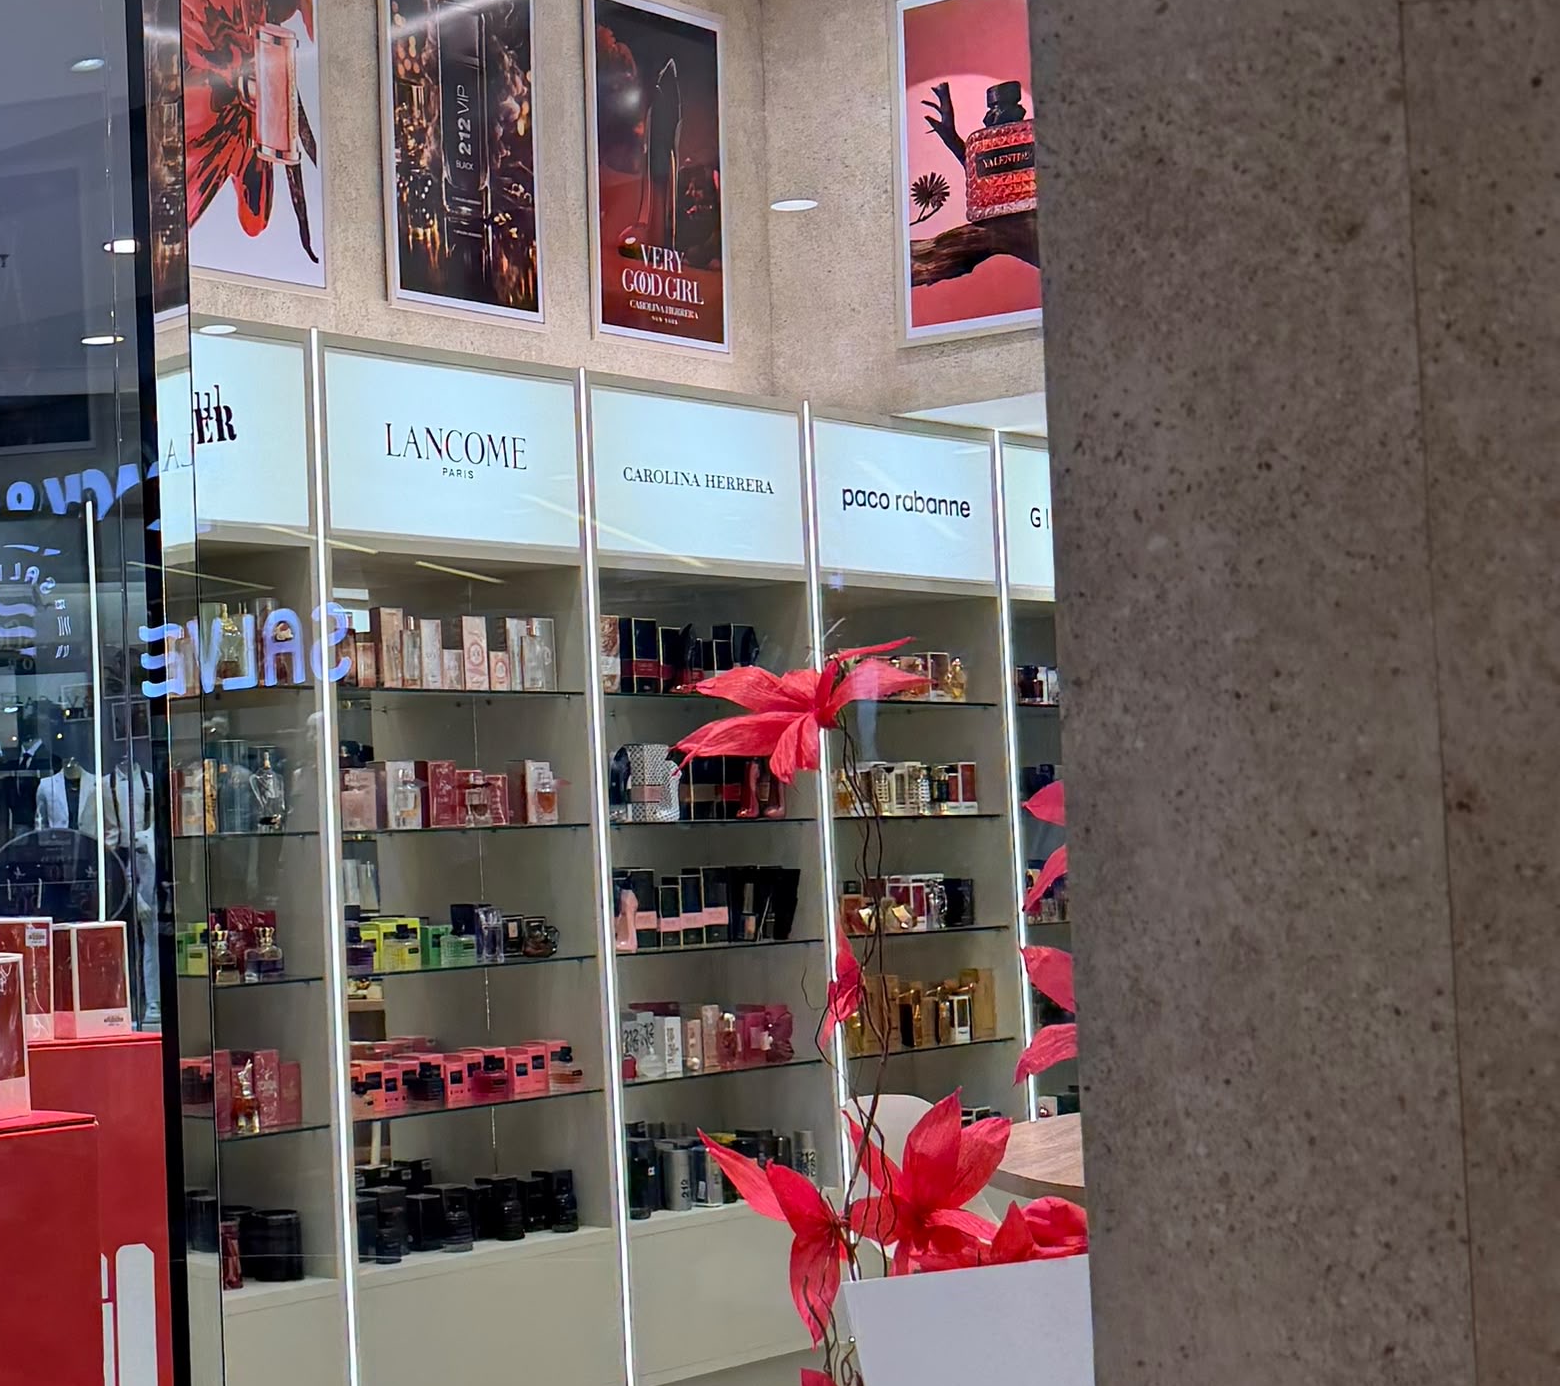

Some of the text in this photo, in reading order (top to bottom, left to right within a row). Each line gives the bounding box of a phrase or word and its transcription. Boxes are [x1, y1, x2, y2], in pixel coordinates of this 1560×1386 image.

[456, 84, 473, 156] 212 VIP
[640, 243, 685, 274] VERY
[622, 268, 705, 305] GOOD GIRL
[385, 423, 527, 470] LANCOME
[442, 467, 474, 479] PARIS
[623, 466, 774, 494] CAROLINA HERRERA
[842, 486, 971, 519] paco rabanne
